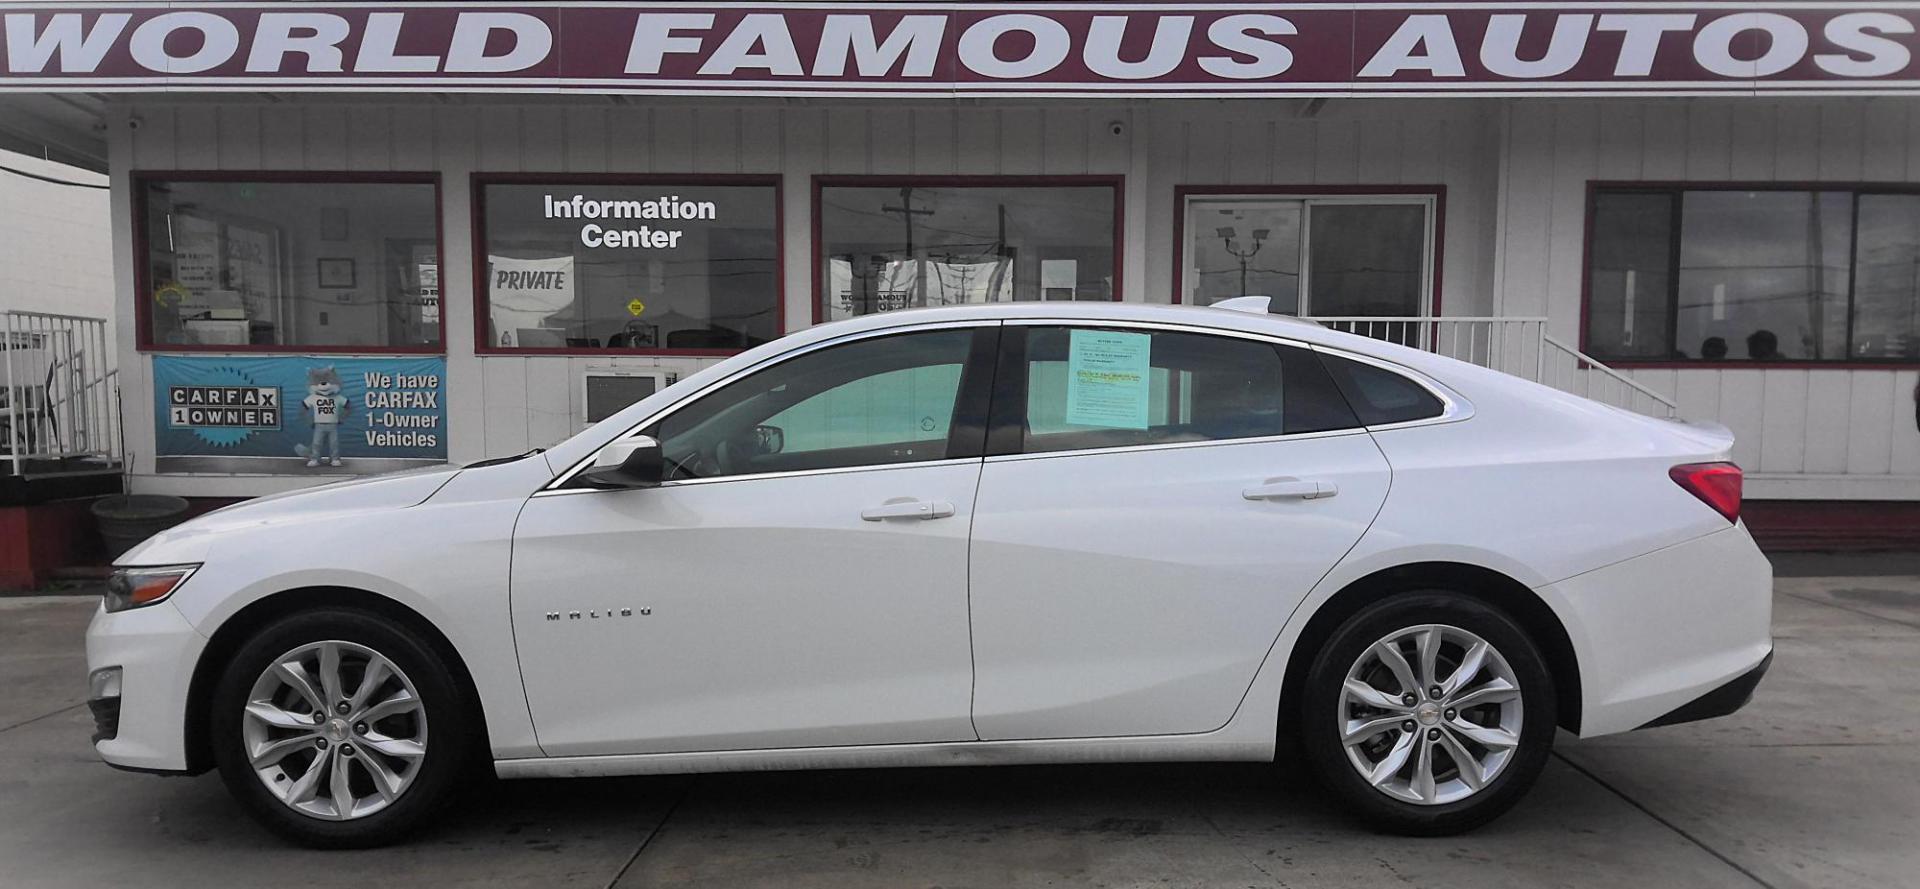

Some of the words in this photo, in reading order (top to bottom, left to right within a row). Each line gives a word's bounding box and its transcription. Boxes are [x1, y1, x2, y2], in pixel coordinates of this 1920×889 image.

[4, 10, 553, 75] WORLD
[624, 13, 1299, 79] FAMOUS
[1356, 12, 1916, 79] AUTOS
[544, 194, 716, 219] Information
[580, 223, 682, 248] Center
[496, 269, 565, 290] PRIVATE
[364, 372, 391, 388] We
[397, 373, 438, 389] have
[173, 389, 275, 406] CARFAX
[316, 398, 335, 407] CAR
[364, 391, 438, 409] CARFAX
[191, 411, 275, 424] OWNER
[318, 406, 335, 415] FOX
[366, 412, 439, 428] 1-Owner
[365, 431, 437, 447] Vehicles
[546, 606, 651, 621] MALIBU
